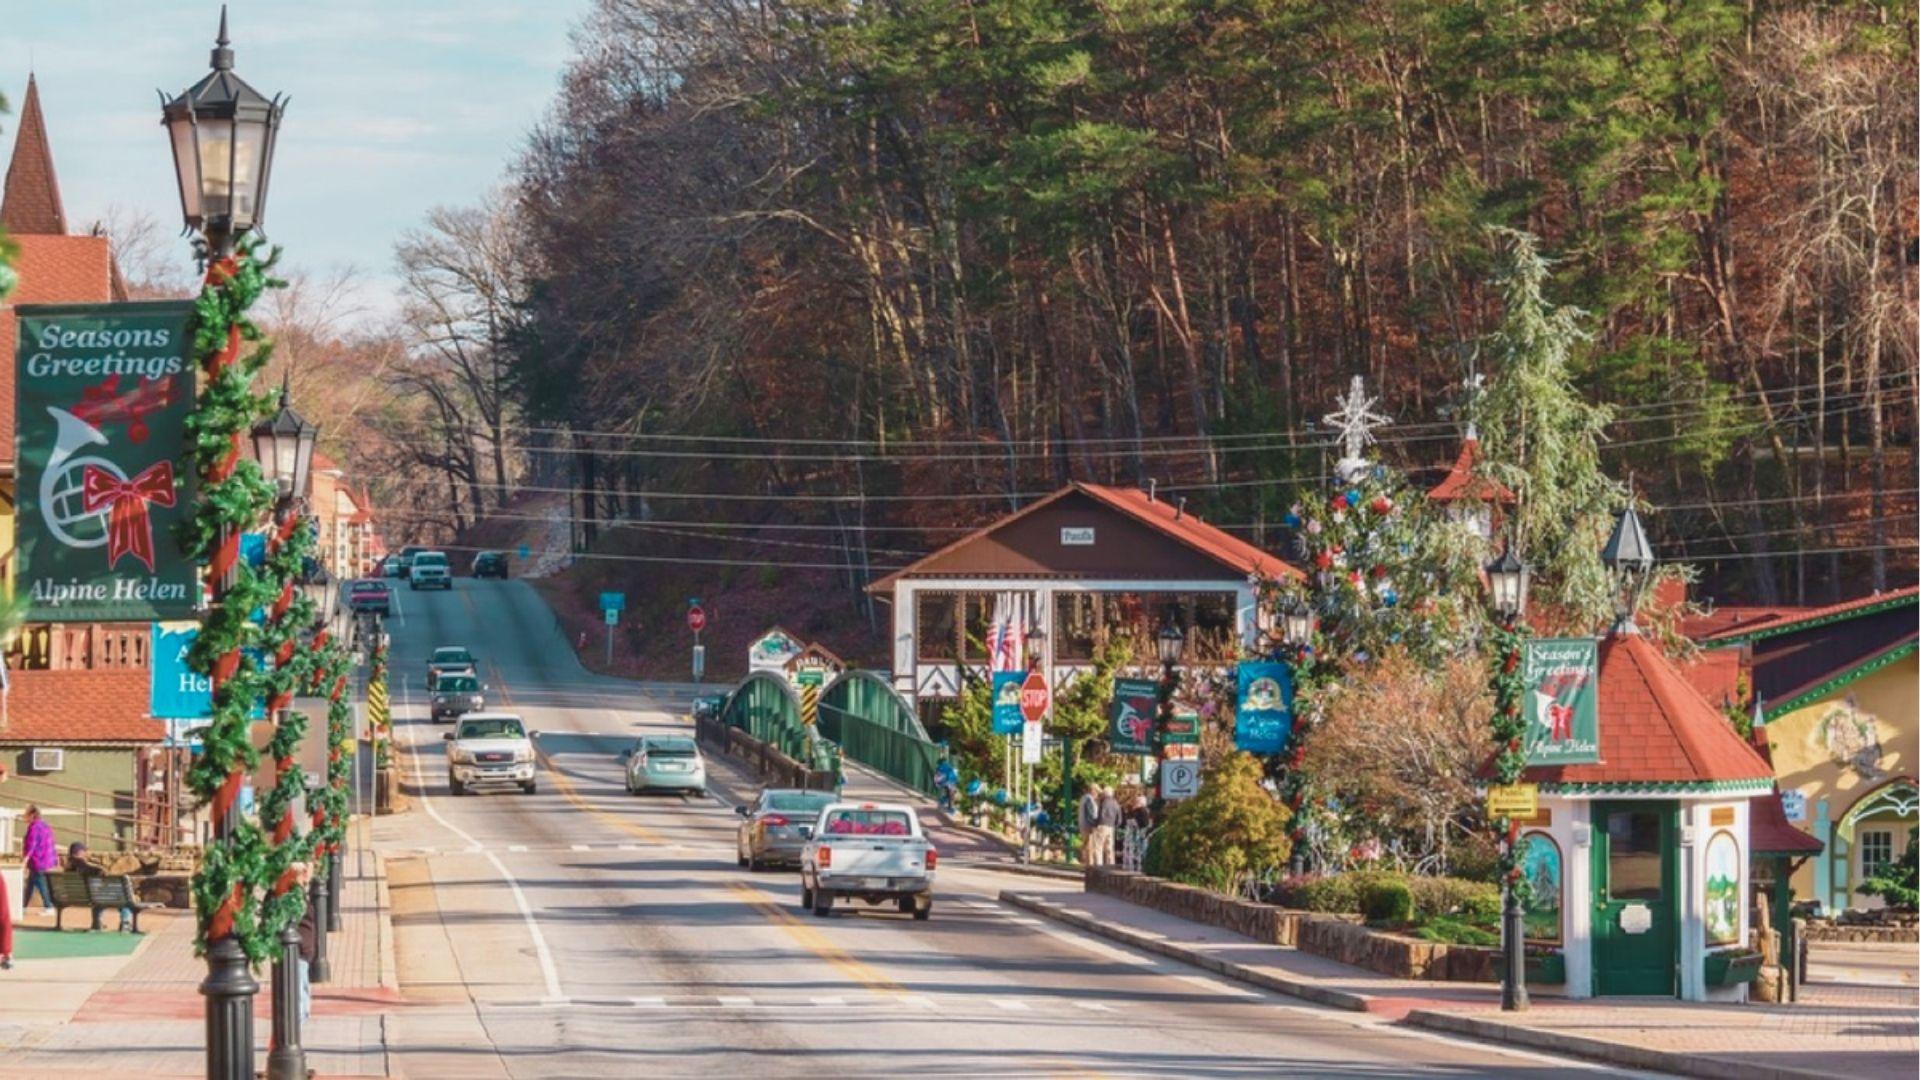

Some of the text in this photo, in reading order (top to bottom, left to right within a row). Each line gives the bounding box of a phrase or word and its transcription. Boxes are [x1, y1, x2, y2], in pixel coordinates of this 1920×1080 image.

[39, 324, 170, 350] Seasons
[27, 351, 182, 379] Greetings
[29, 577, 186, 606] Alpine Helen
[179, 672, 213, 692] Hel
[1023, 689, 1047, 707] STOP
